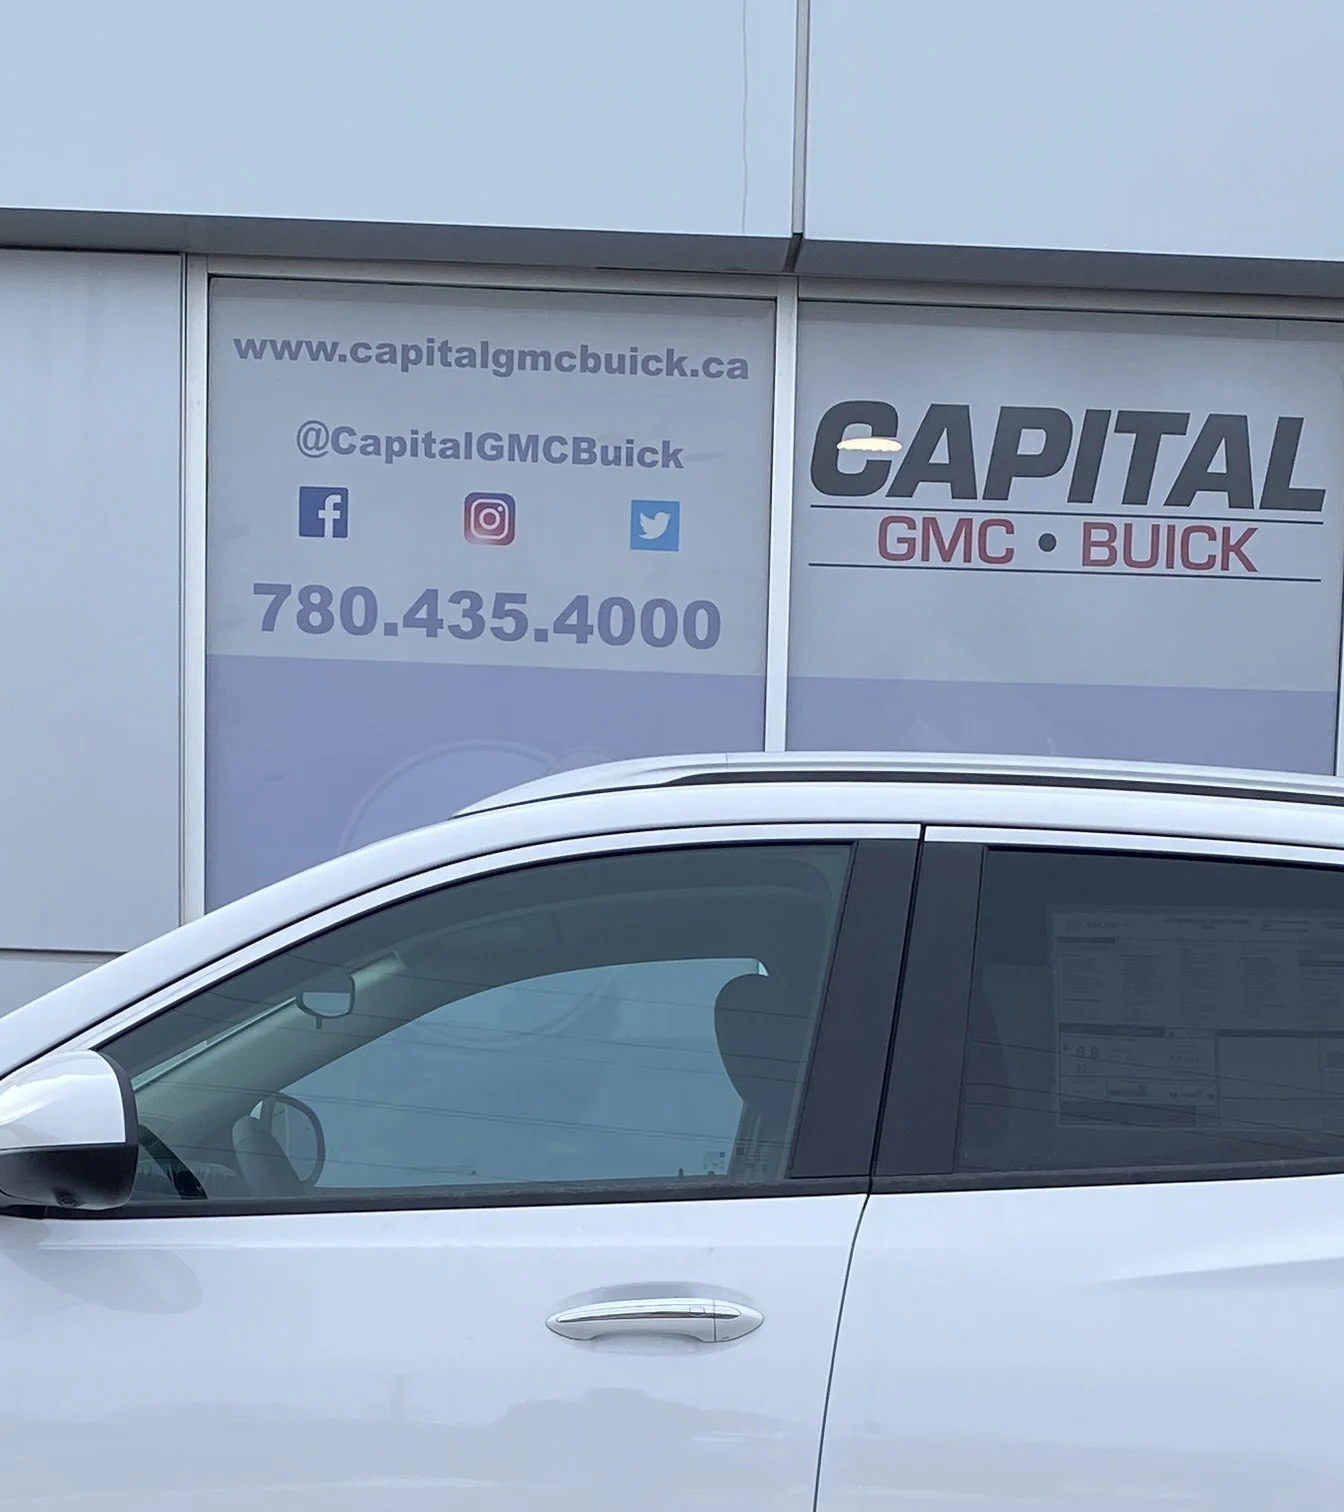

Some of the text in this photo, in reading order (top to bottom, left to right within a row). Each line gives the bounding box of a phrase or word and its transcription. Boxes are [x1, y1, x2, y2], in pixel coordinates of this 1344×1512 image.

[233, 336, 750, 380] www.capitalgmcbuick.ca
[296, 420, 685, 470] @CapitalGMCBuick
[809, 399, 1327, 513] CAPITAL
[877, 515, 1259, 573] GMC BUICK
[253, 583, 722, 650] 780.435.4000
